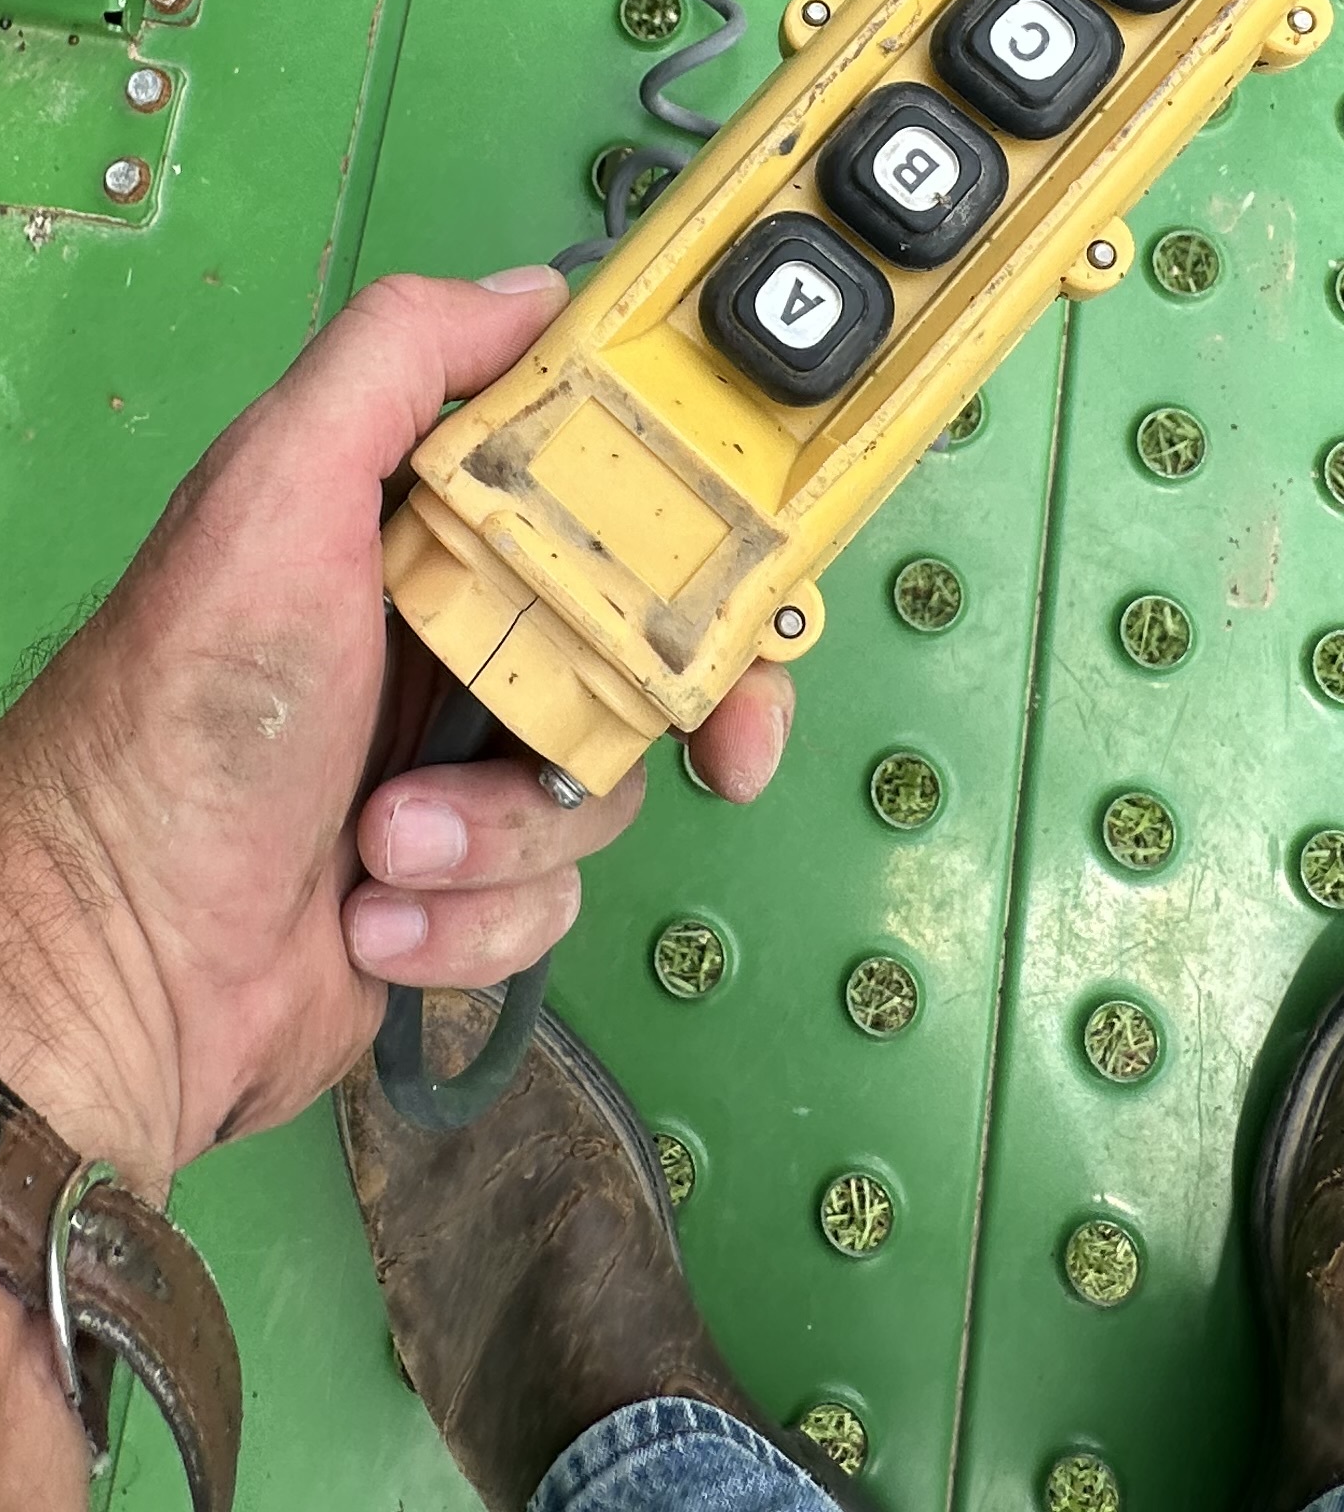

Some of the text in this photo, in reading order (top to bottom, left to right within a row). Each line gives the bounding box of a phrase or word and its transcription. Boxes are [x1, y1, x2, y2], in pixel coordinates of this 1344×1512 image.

[1008, 22, 1050, 61] C
[892, 148, 940, 194] B
[780, 277, 826, 326] A
